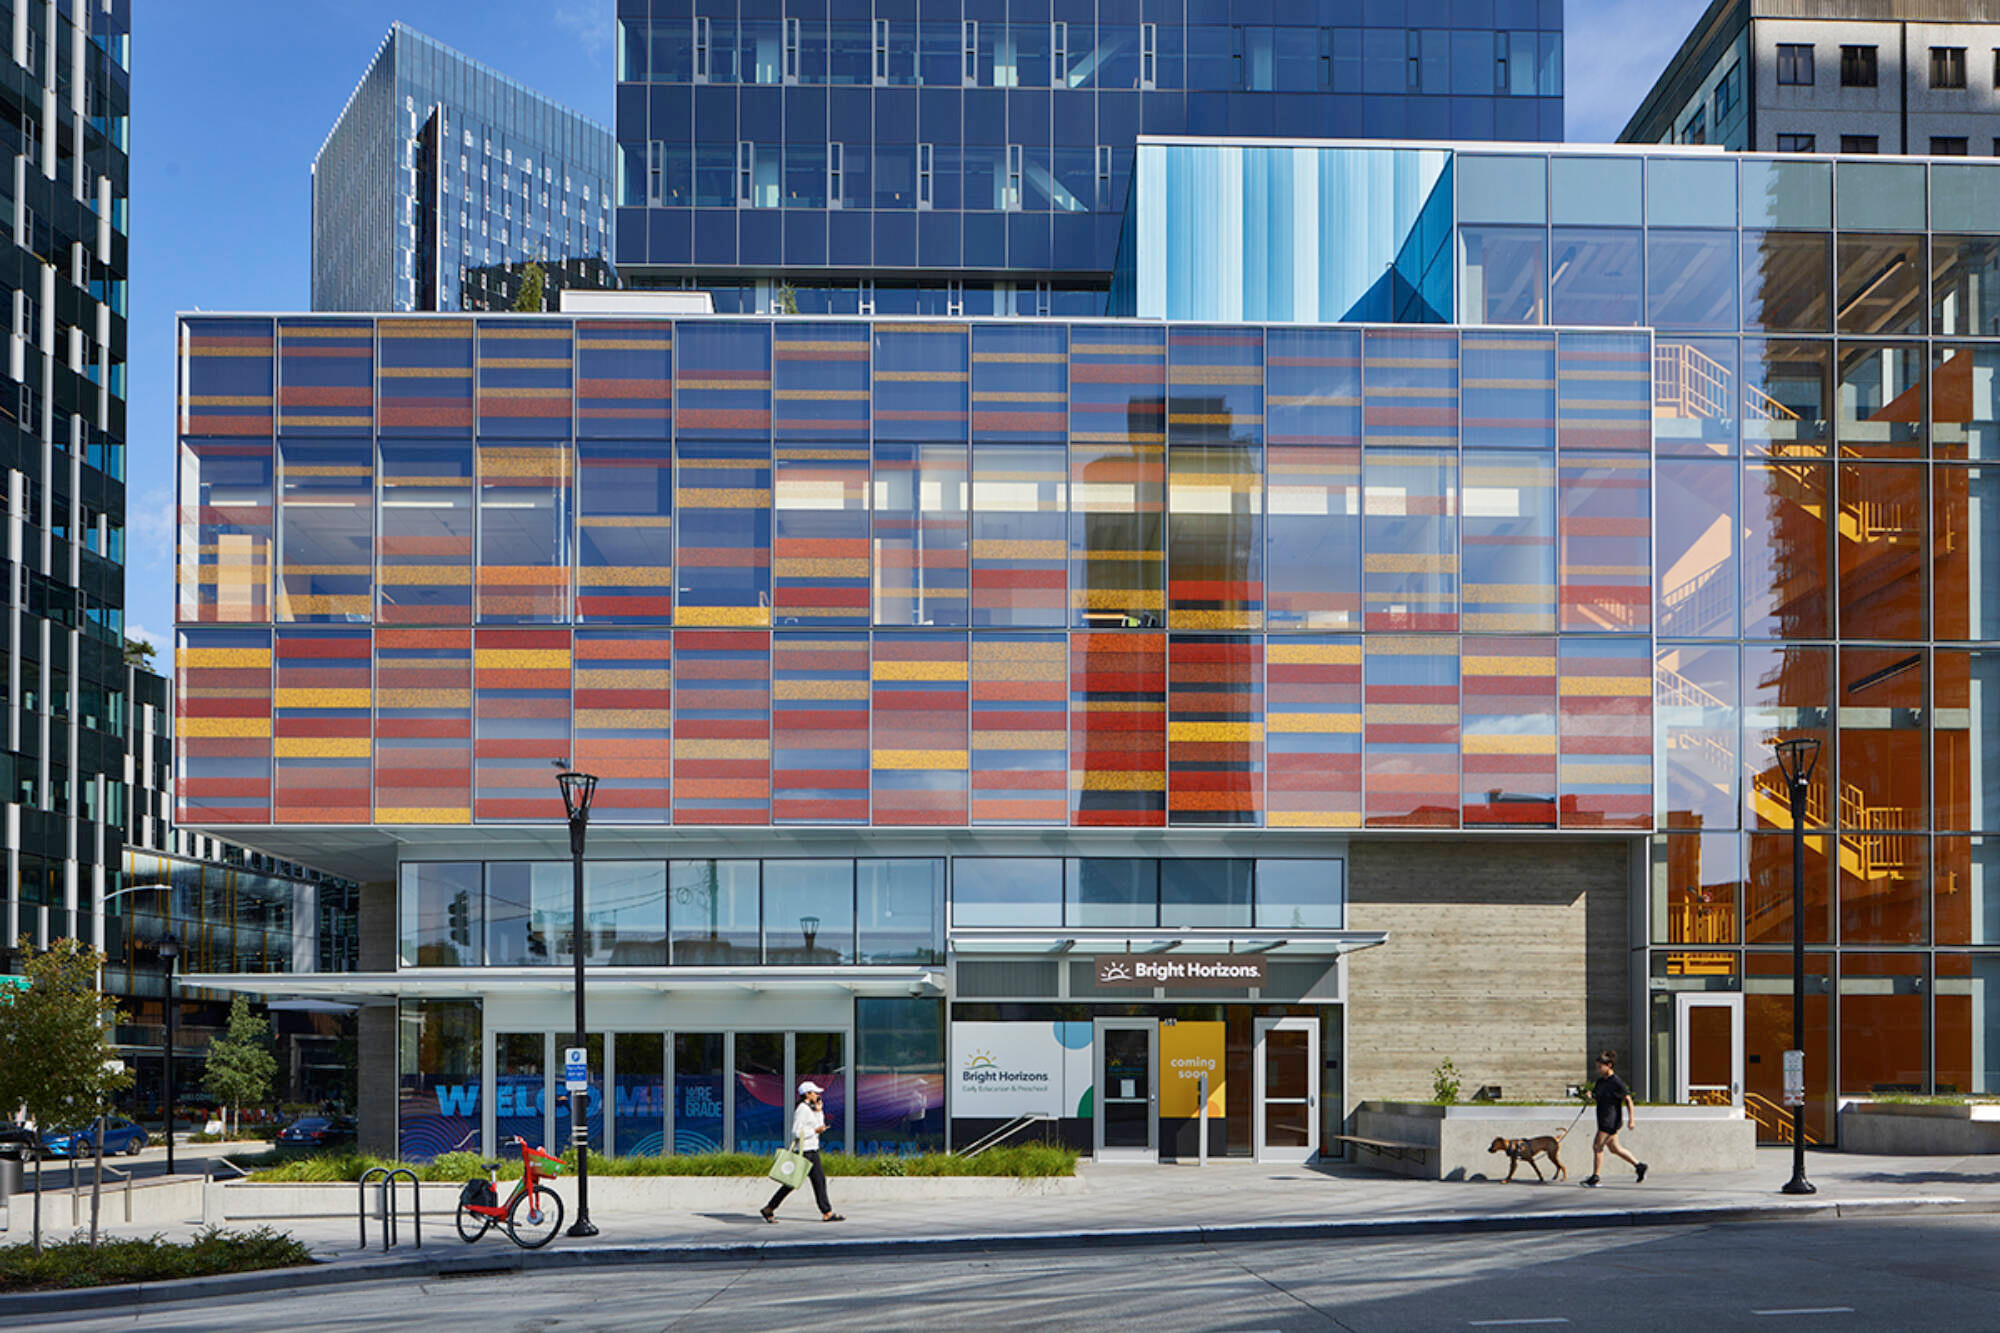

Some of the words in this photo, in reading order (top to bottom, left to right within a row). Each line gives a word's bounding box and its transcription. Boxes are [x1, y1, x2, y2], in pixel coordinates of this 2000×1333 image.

[1135, 961, 1185, 981] Bright
[1170, 1056, 1216, 1071] coming
[962, 1070, 997, 1084] Bright
[999, 1070, 1049, 1081] Horizons
[1178, 1070, 1208, 1079] soon
